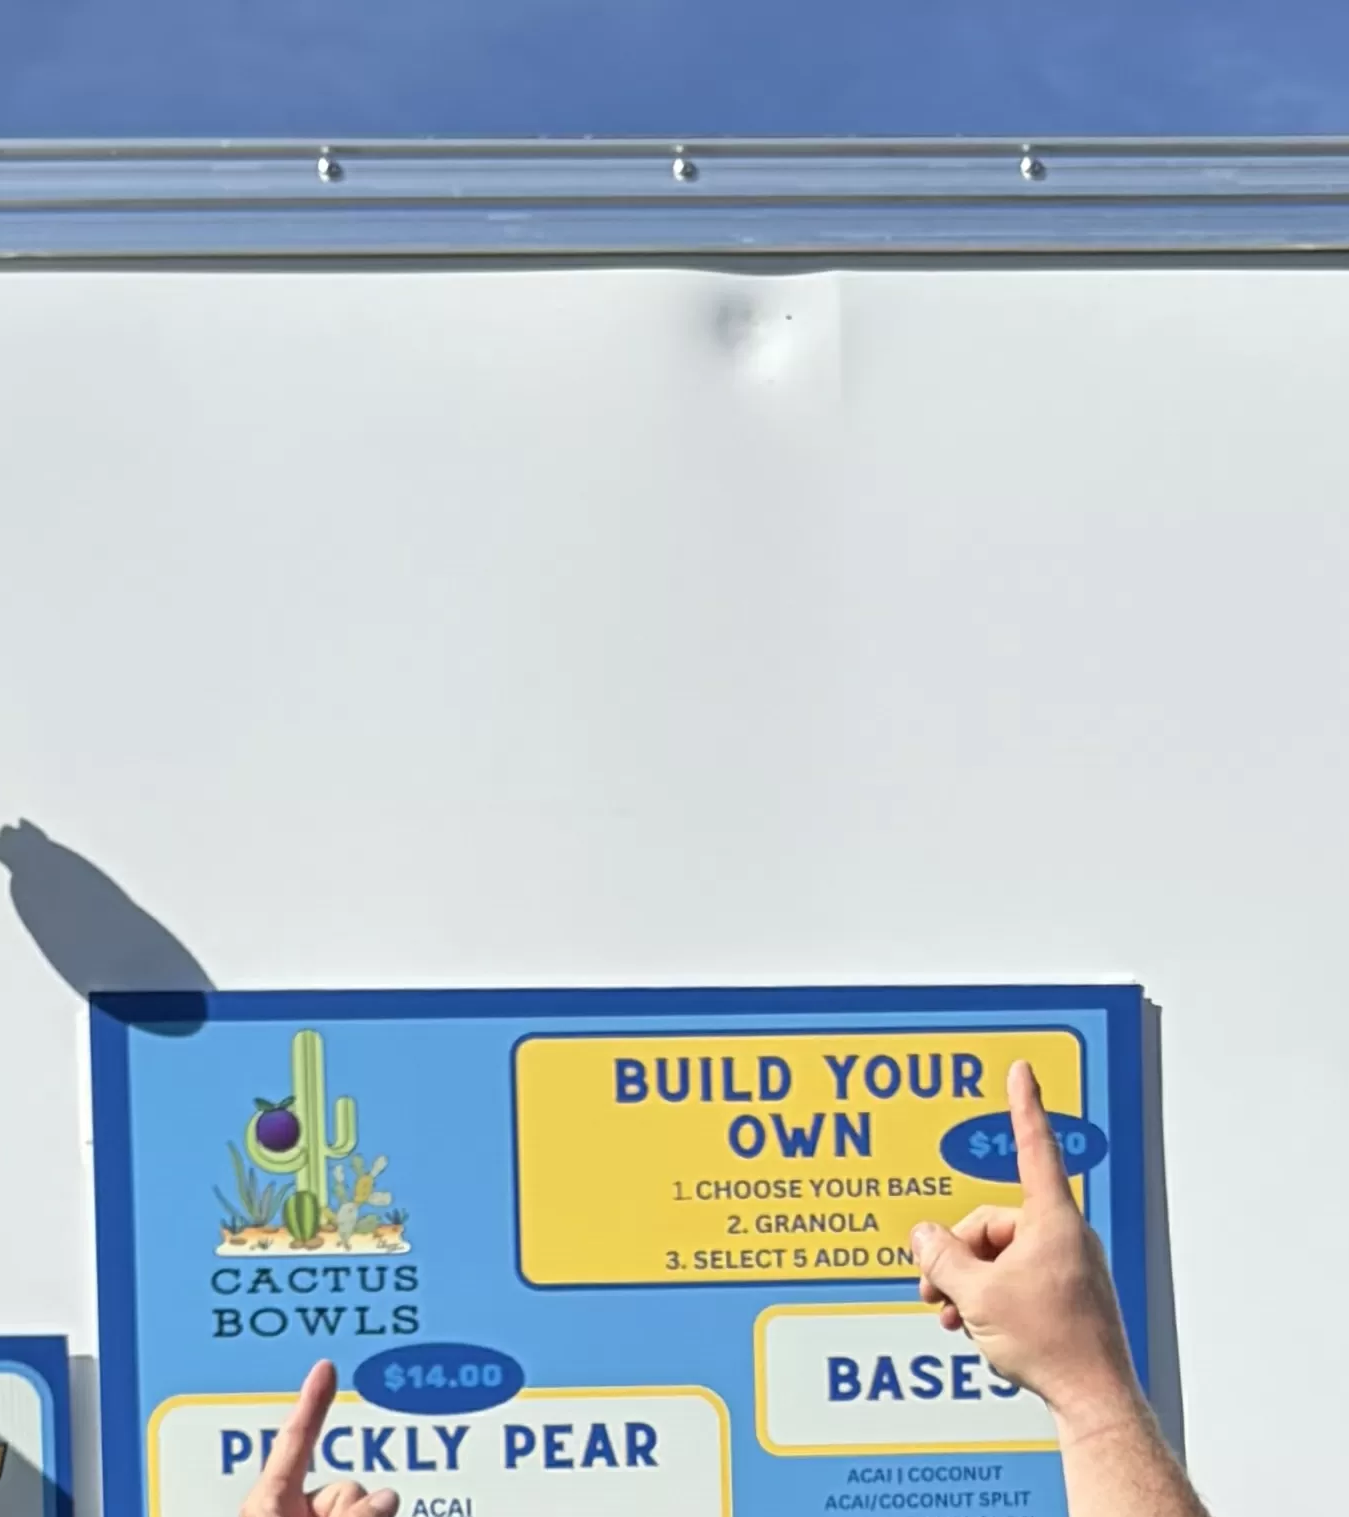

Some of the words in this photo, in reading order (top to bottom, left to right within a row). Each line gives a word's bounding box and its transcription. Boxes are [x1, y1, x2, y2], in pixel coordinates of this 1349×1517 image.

[614, 1054, 792, 1104] BUILD
[824, 1053, 984, 1100] YOUR
[728, 1111, 872, 1160] OWN
[695, 1179, 802, 1200] CHOOSE
[809, 1178, 881, 1198] YOUR
[888, 1176, 953, 1197] BASE
[727, 1215, 749, 1235] 2.
[755, 1213, 880, 1234] GRANOLA
[665, 1250, 688, 1270] 3.
[694, 1249, 787, 1269] SELECT
[793, 1248, 807, 1268] 5
[814, 1247, 870, 1268] ADD
[211, 1265, 419, 1294] CACTUS
[212, 1306, 420, 1338] BOWLS
[384, 1363, 502, 1390] $14.00
[220, 1426, 470, 1475] PCKLY
[503, 1422, 660, 1469] PEAR
[847, 1468, 892, 1484] ACAI
[907, 1466, 1003, 1483] COCONUT
[824, 1492, 975, 1512] ACAI/COCONUT
[979, 1491, 1031, 1507] SPLIT
